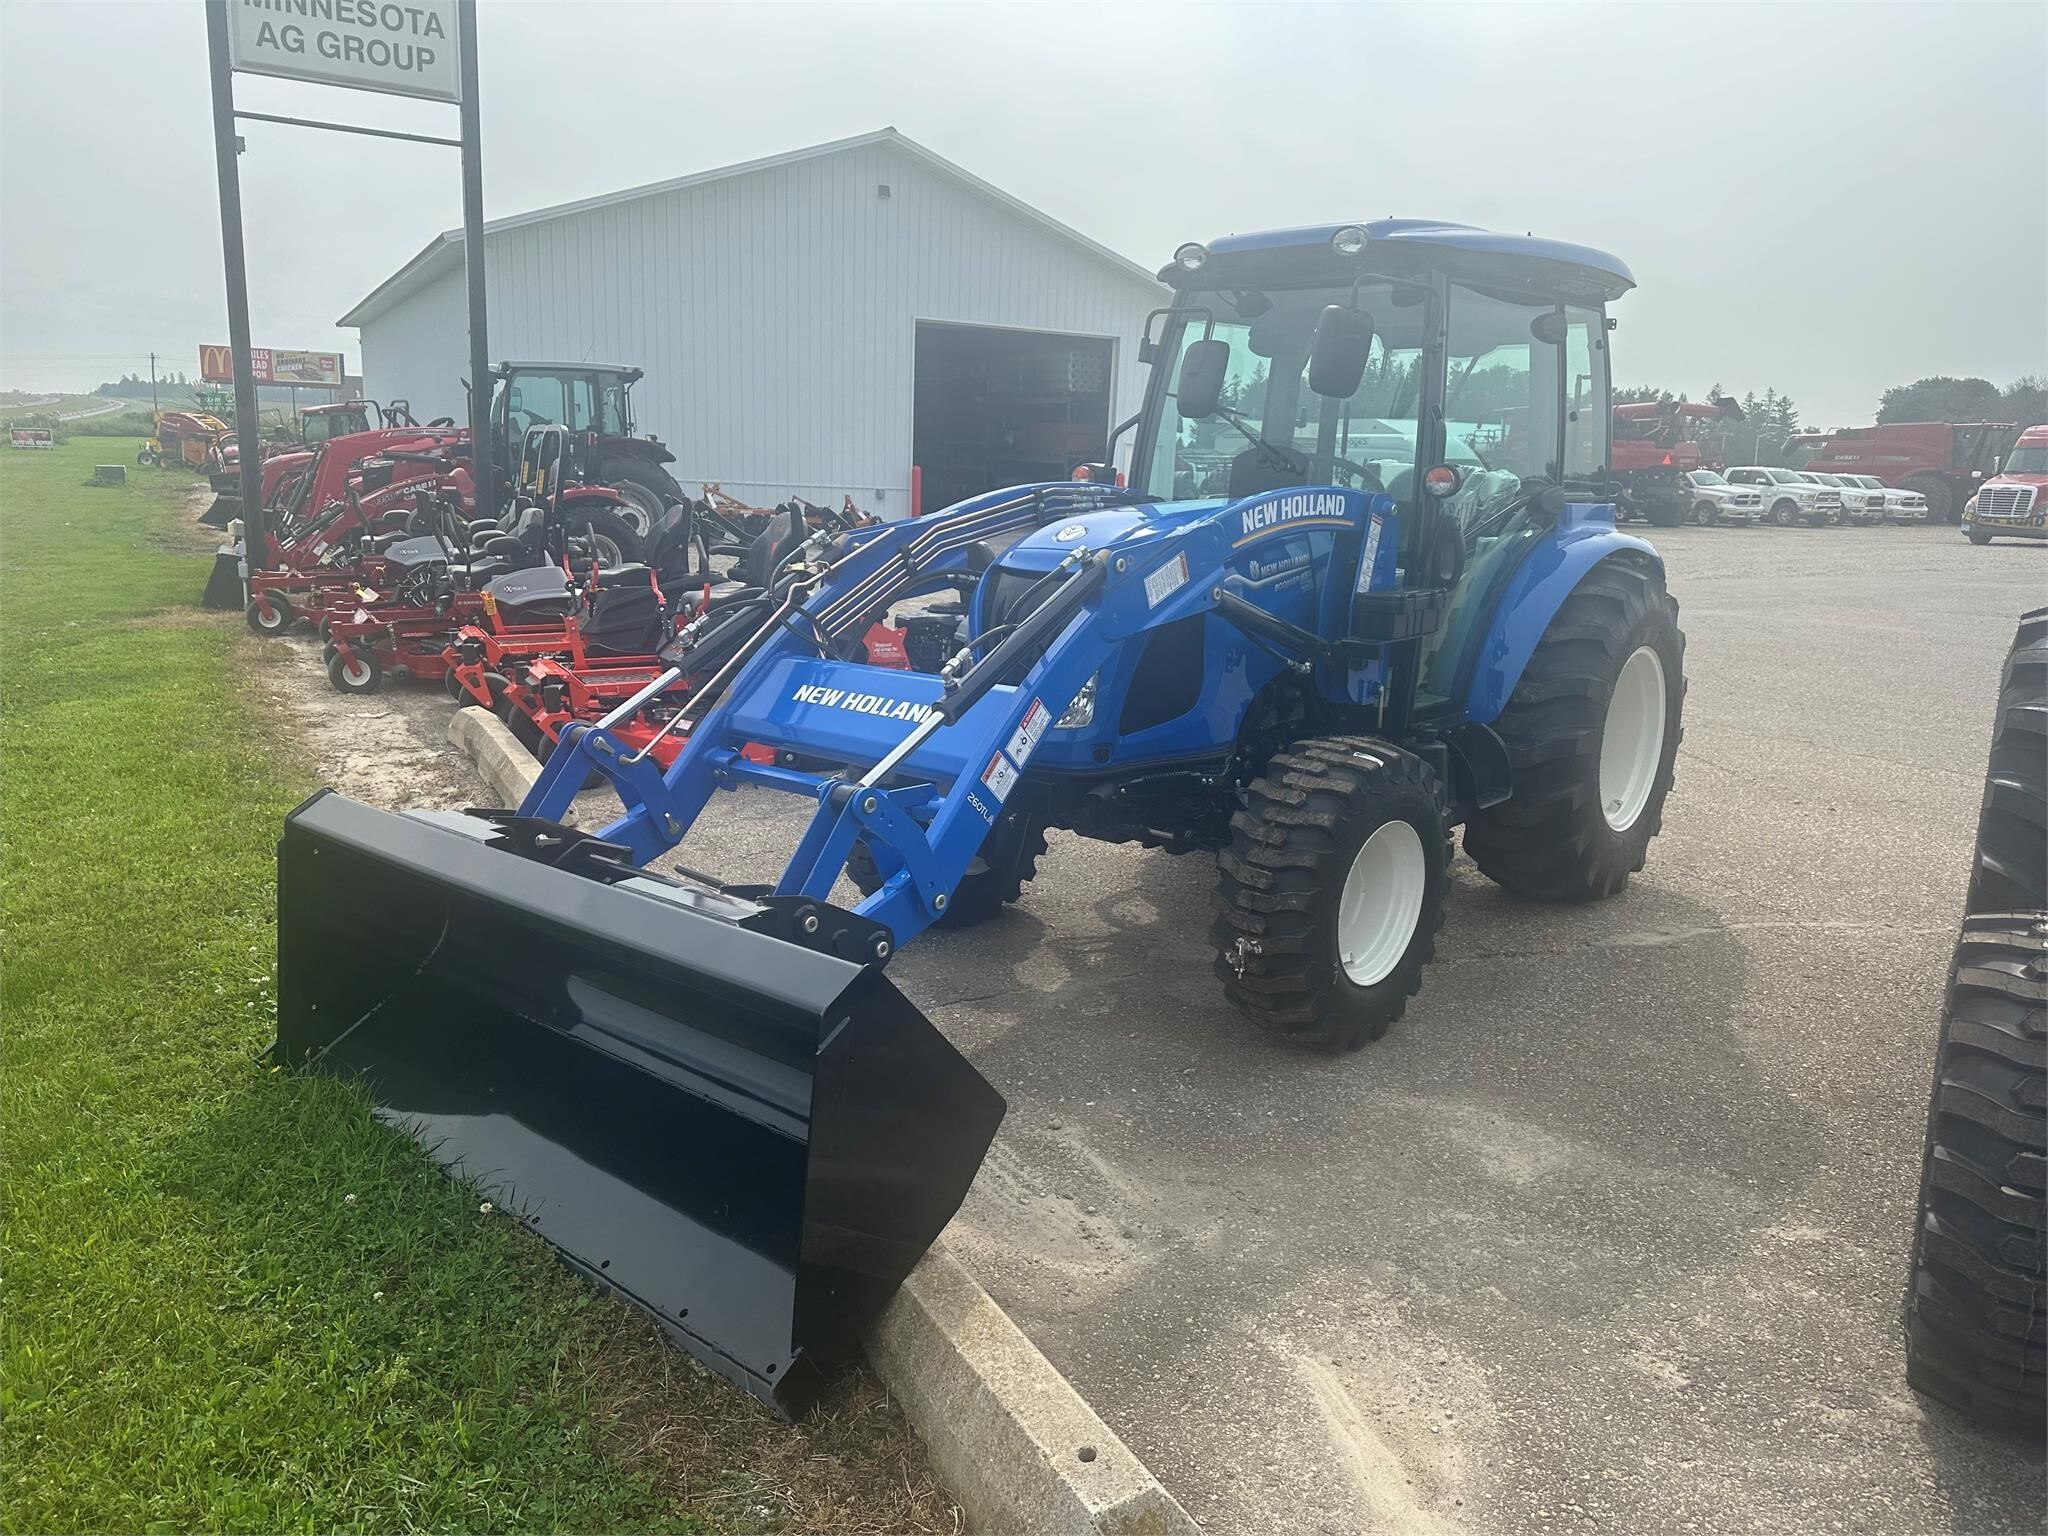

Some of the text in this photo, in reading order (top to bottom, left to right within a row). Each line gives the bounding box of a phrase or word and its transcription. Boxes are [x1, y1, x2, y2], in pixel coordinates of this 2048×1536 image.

[242, 0, 445, 39] NNESOTA
[256, 21, 435, 72] AG GROUP
[1242, 494, 1346, 534] NEW HOLLAND
[792, 684, 846, 707] NEW
[967, 792, 994, 826] 260TLA
